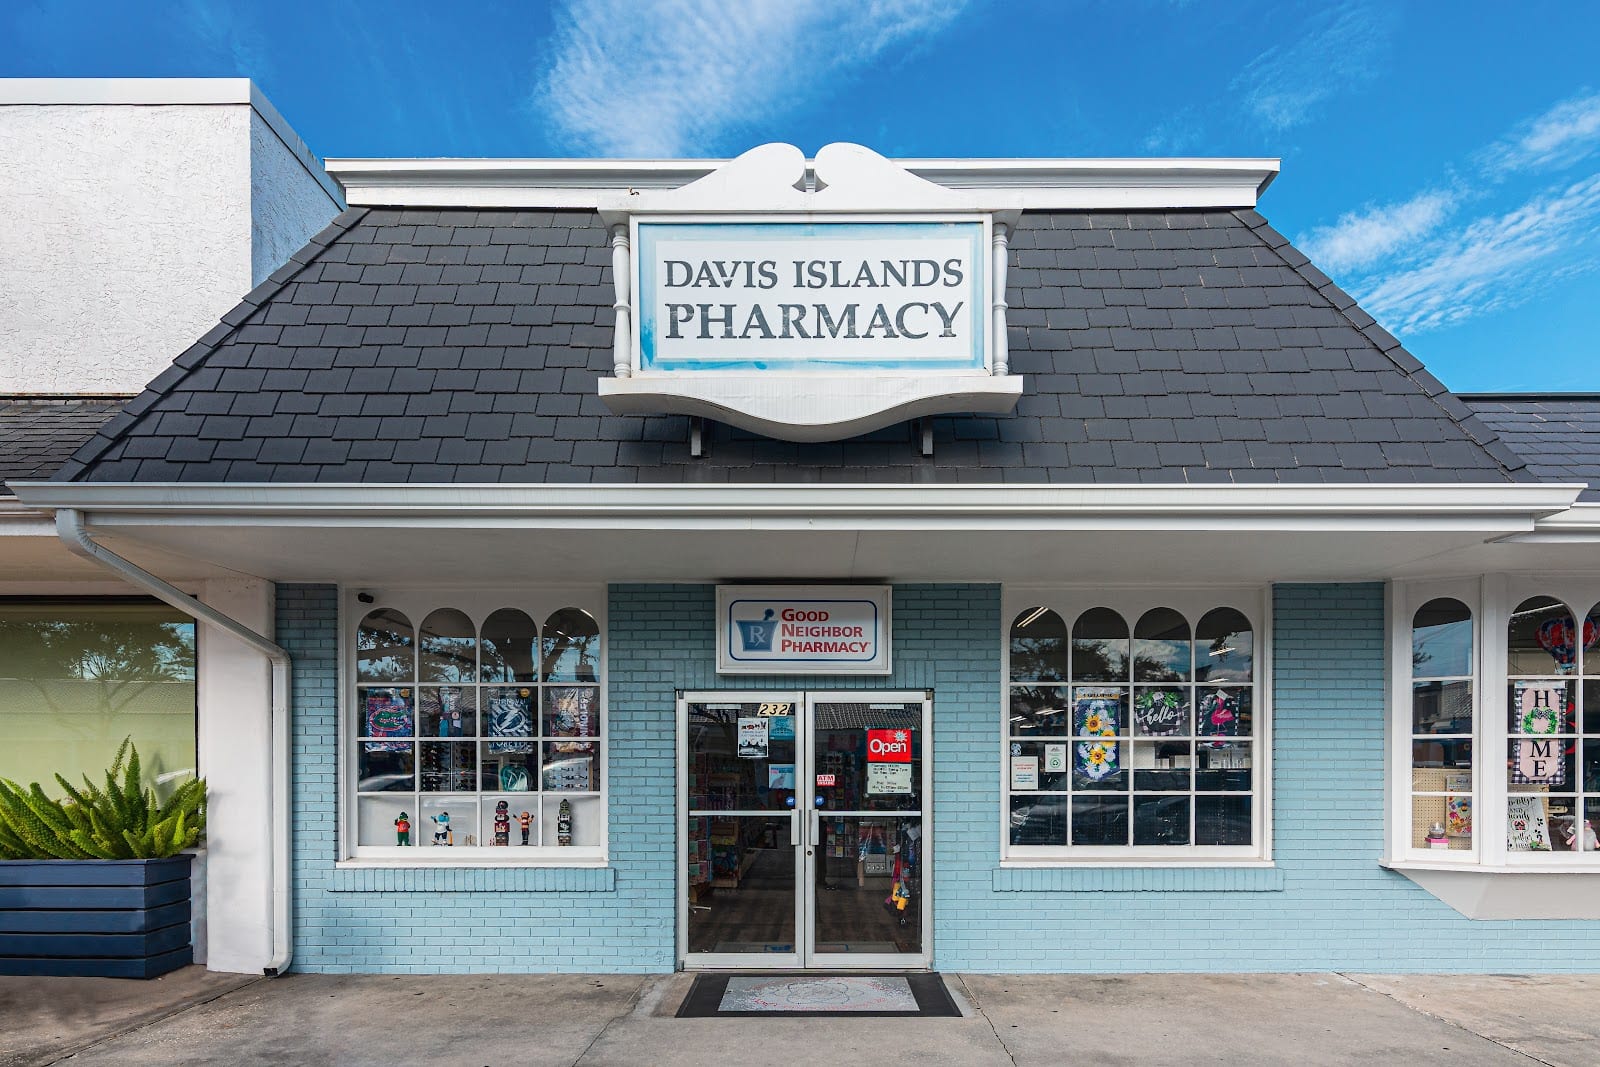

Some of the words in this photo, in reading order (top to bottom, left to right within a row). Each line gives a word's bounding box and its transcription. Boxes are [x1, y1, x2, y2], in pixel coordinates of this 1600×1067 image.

[663, 260, 778, 290] DAVIS
[792, 258, 965, 289] ISLANDS
[664, 301, 965, 340] PHARMACY
[781, 608, 829, 622] GOOD
[781, 624, 863, 638] NEIGHBOR
[781, 639, 868, 653] PHARMACY
[759, 704, 789, 715] 232
[869, 738, 907, 756] Open
